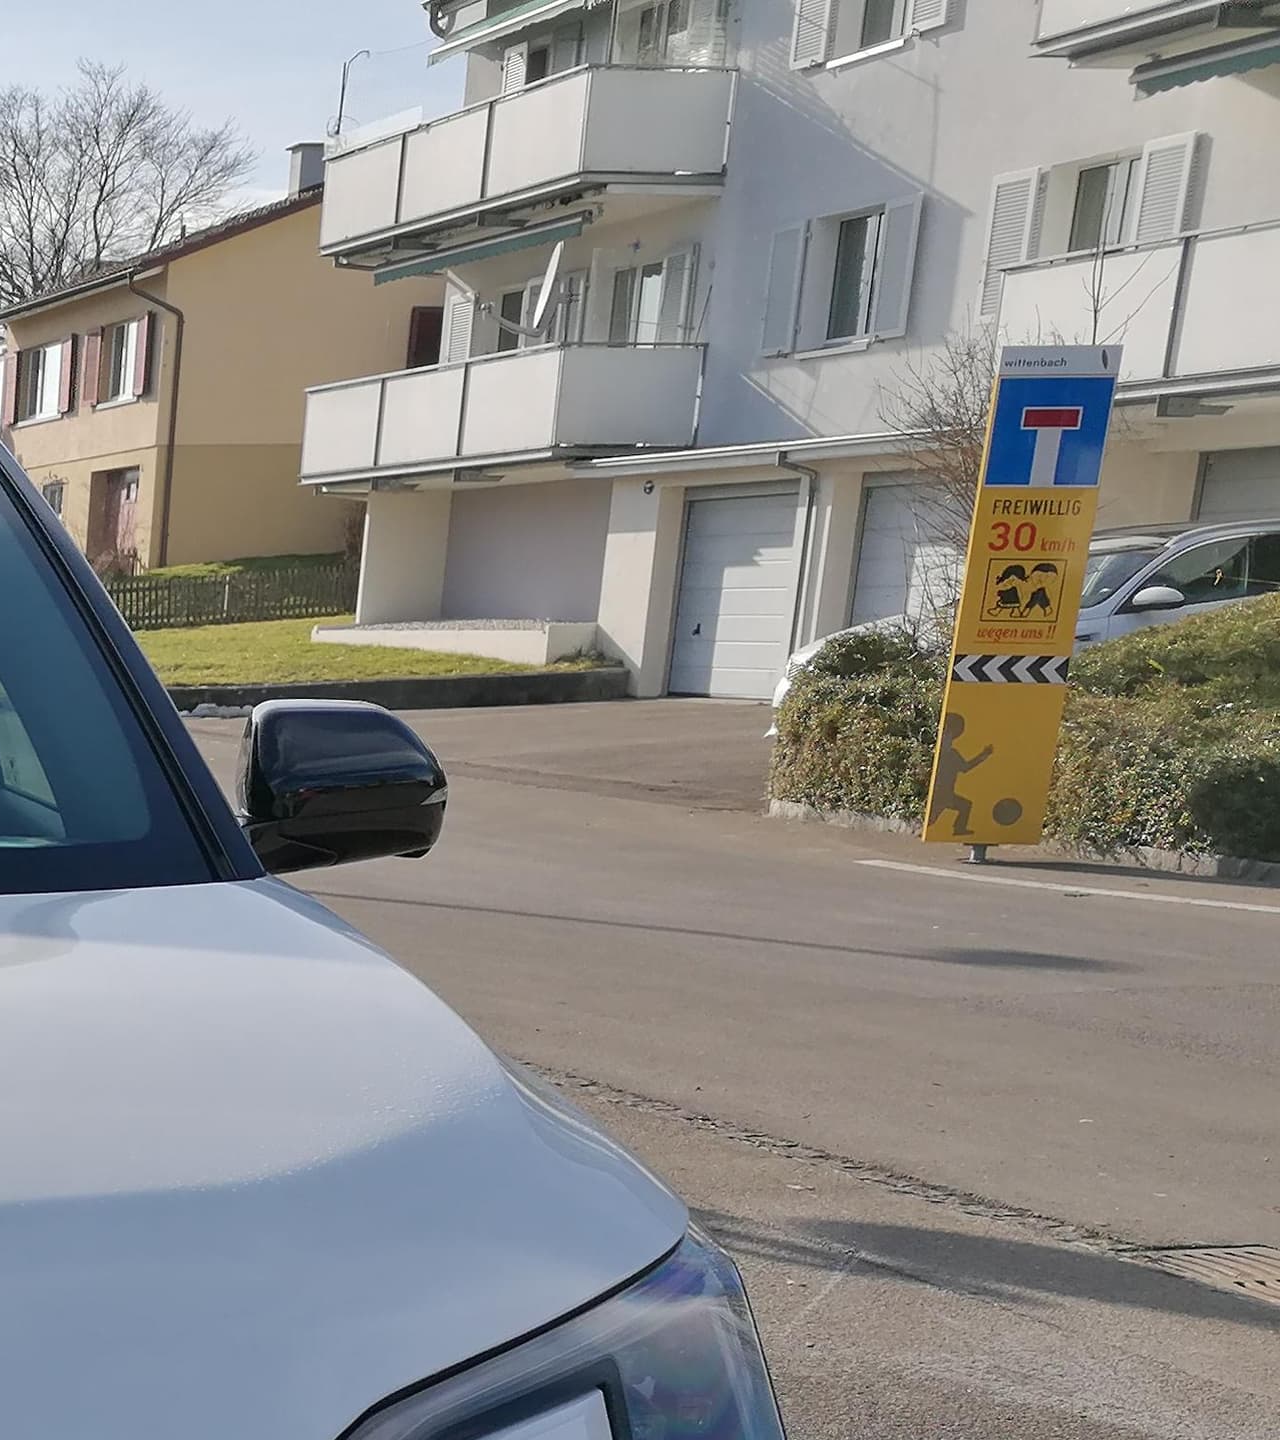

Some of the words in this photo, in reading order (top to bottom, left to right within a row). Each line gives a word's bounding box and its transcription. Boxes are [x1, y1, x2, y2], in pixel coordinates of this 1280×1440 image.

[1004, 357, 1068, 368] wittenbach
[992, 499, 1082, 516] FREIWILLIG
[988, 521, 1037, 552] 30
[1040, 537, 1076, 552] km/h
[976, 627, 1018, 643] wegen
